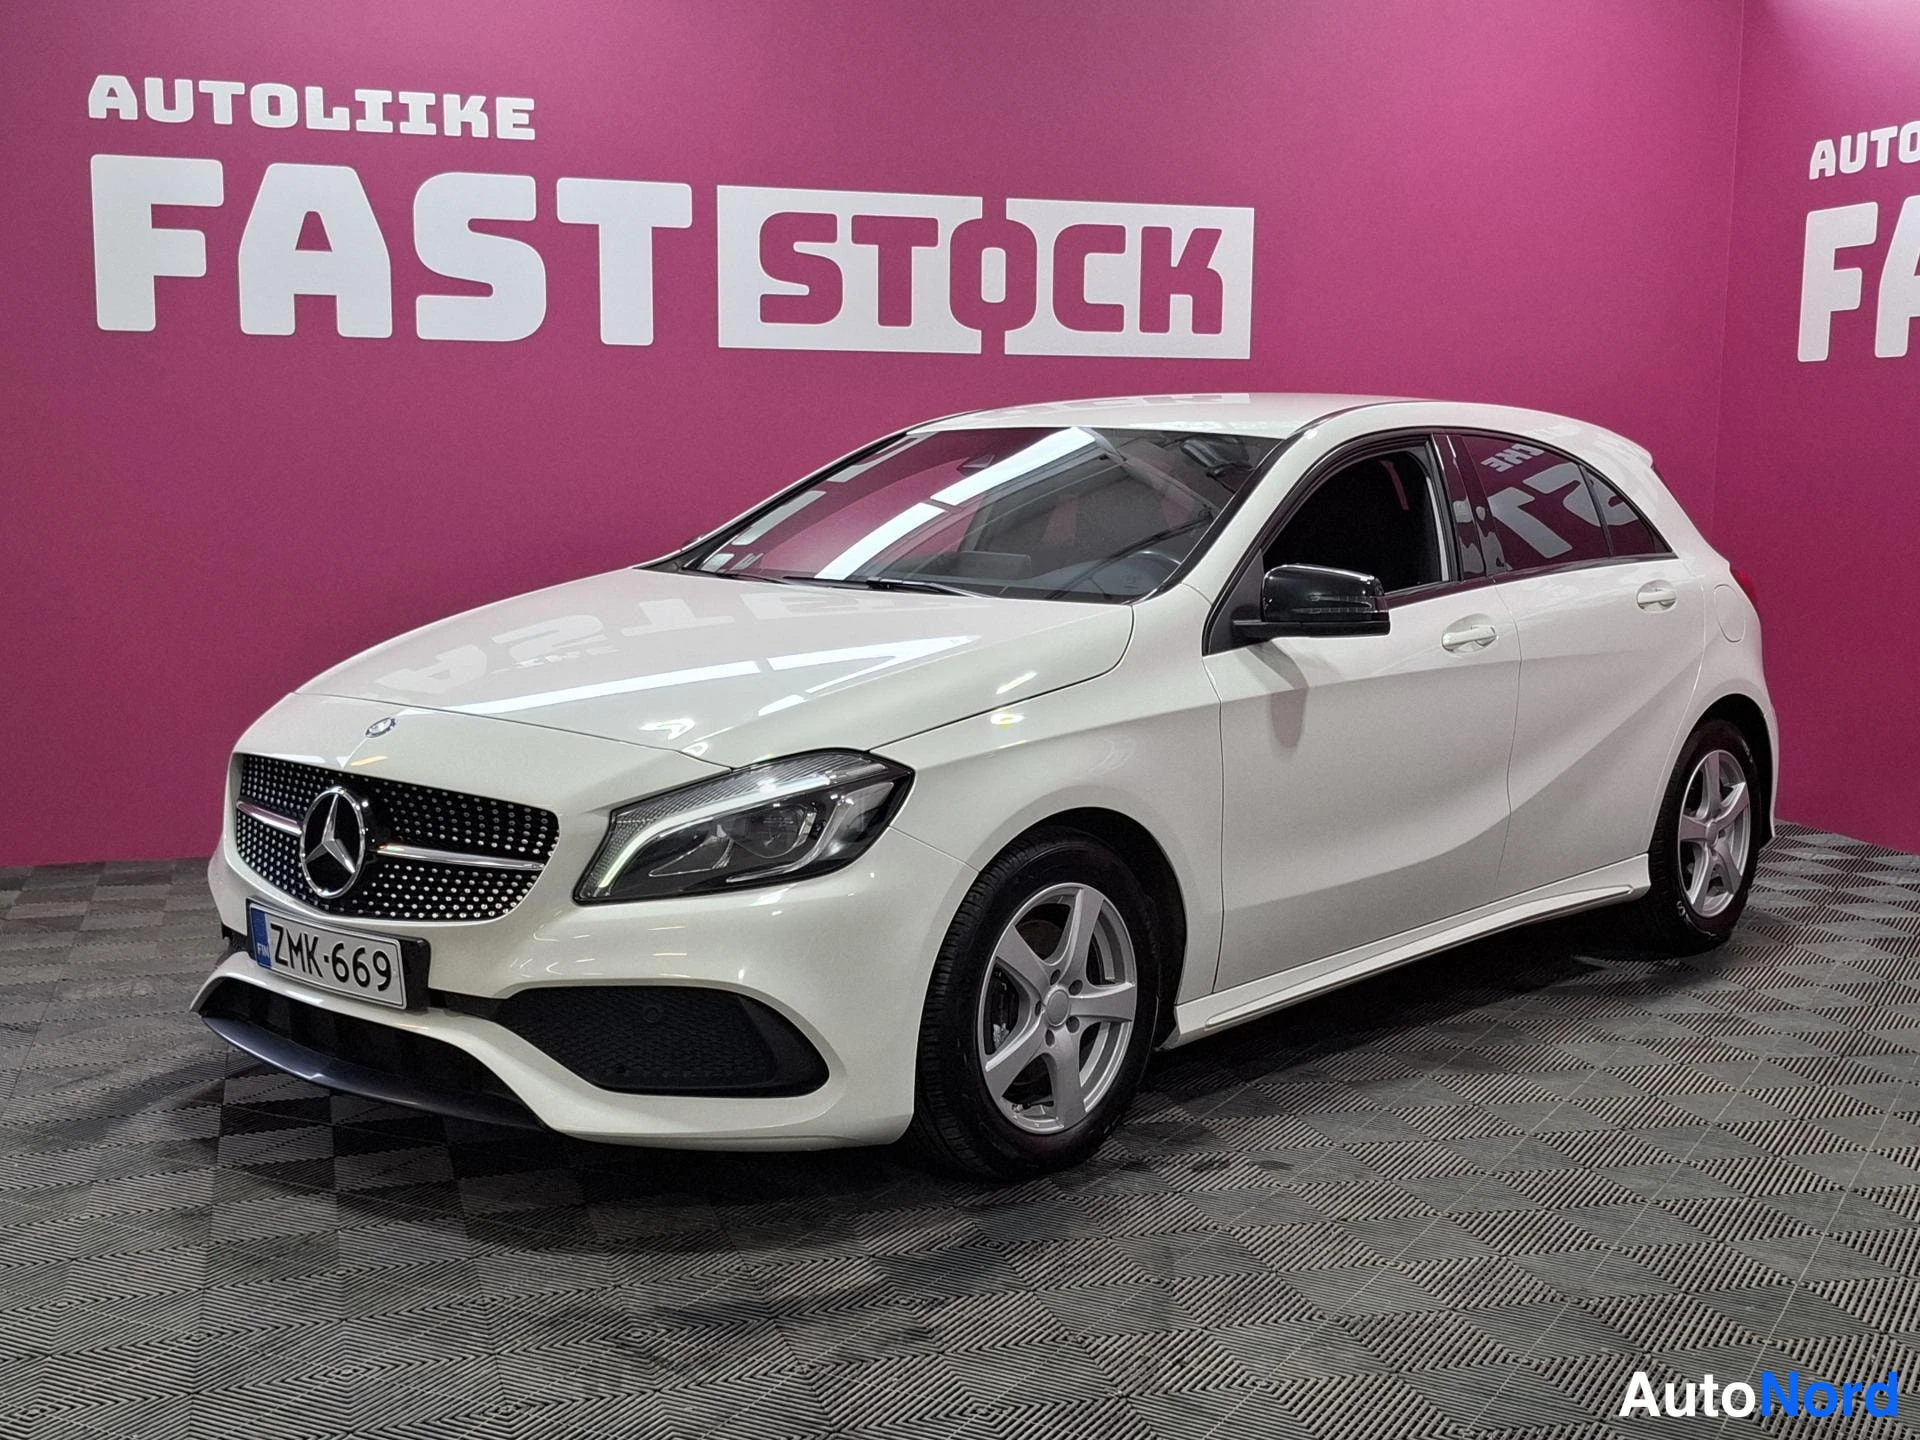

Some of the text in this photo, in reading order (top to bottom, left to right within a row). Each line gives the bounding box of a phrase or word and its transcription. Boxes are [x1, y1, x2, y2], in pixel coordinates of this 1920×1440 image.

[88, 75, 535, 140] AUTOLIIKE
[91, 154, 1224, 346] FAST STOCK
[270, 922, 392, 992] ZMK-669
